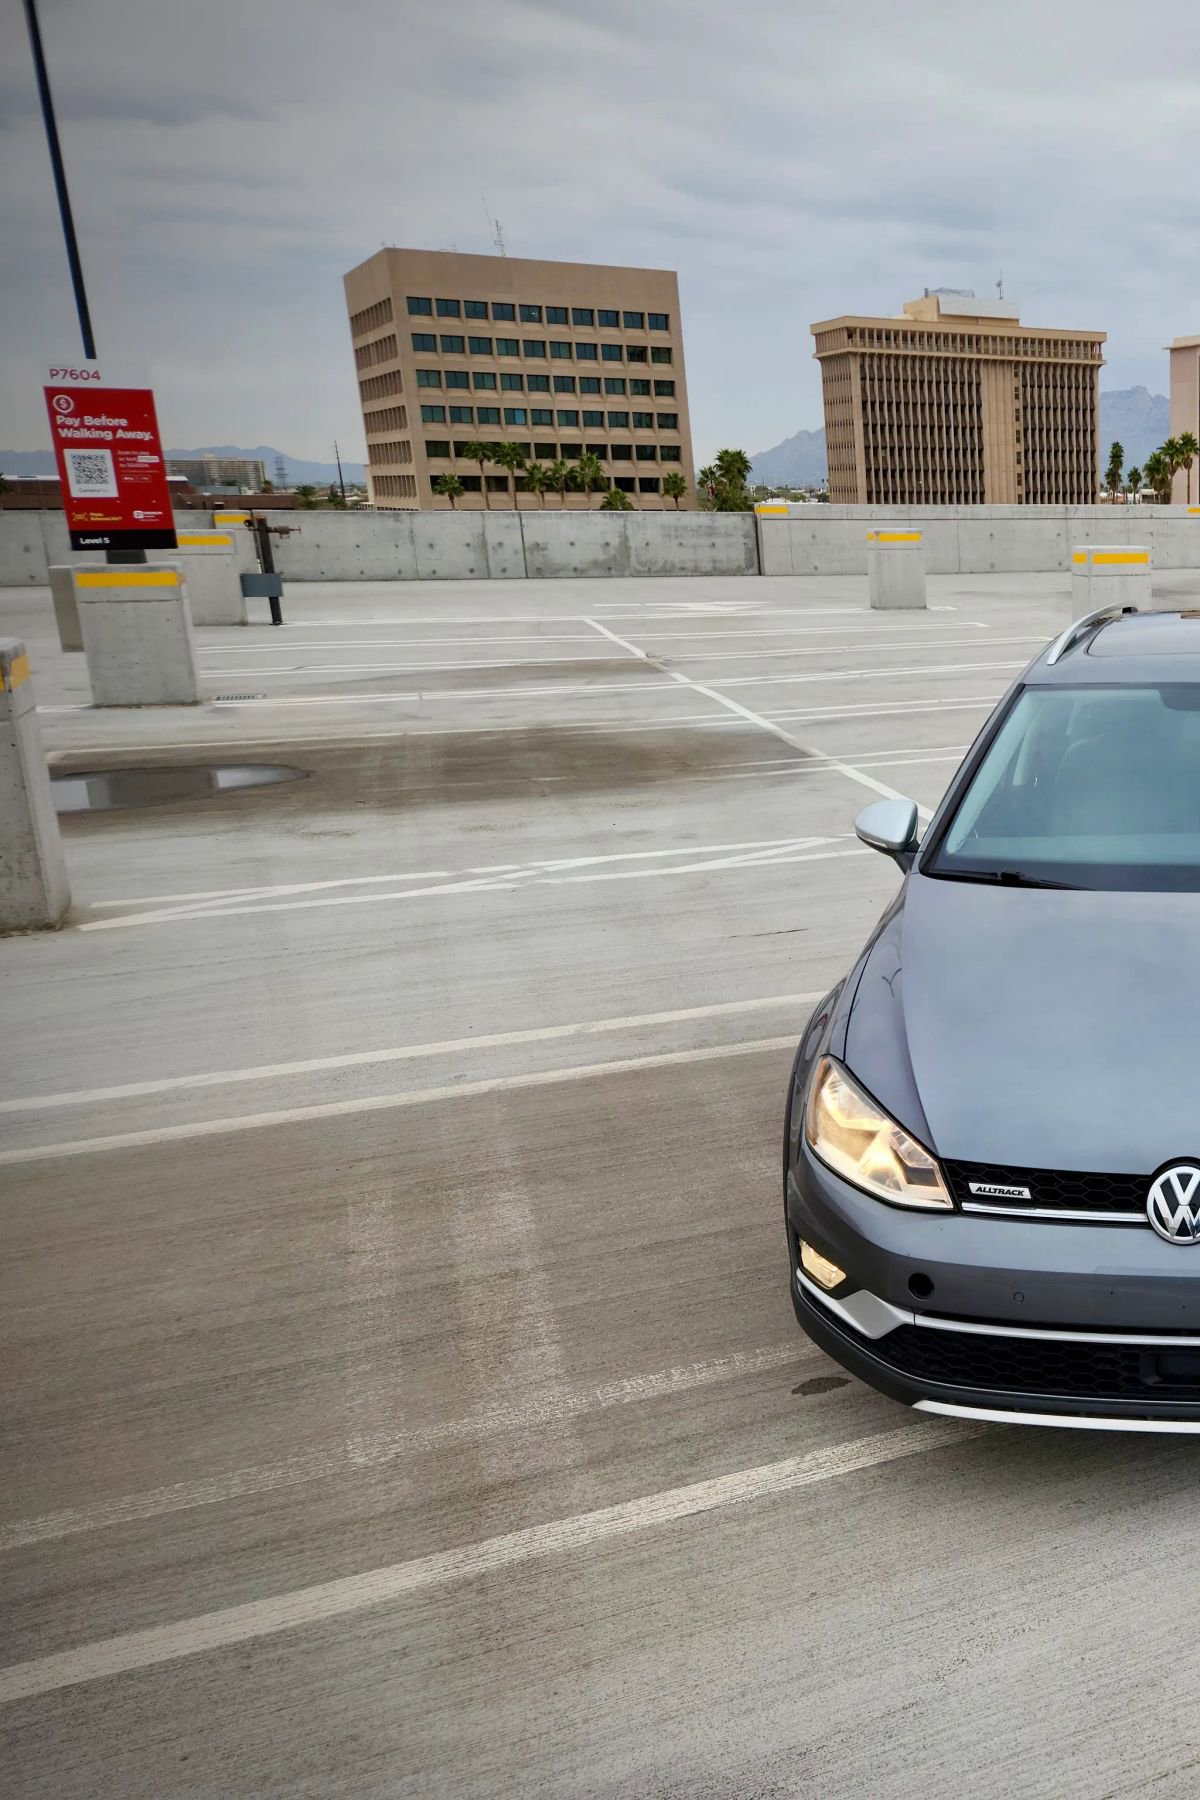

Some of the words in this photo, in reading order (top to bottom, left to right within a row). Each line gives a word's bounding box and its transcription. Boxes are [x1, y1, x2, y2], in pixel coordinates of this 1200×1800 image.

[49, 368, 101, 381] P7604
[56, 415, 80, 427] Pay
[83, 415, 128, 426] Before
[58, 428, 112, 440] Walking
[116, 429, 154, 440] Away.
[975, 1186, 1025, 1197] ALLTRACK
